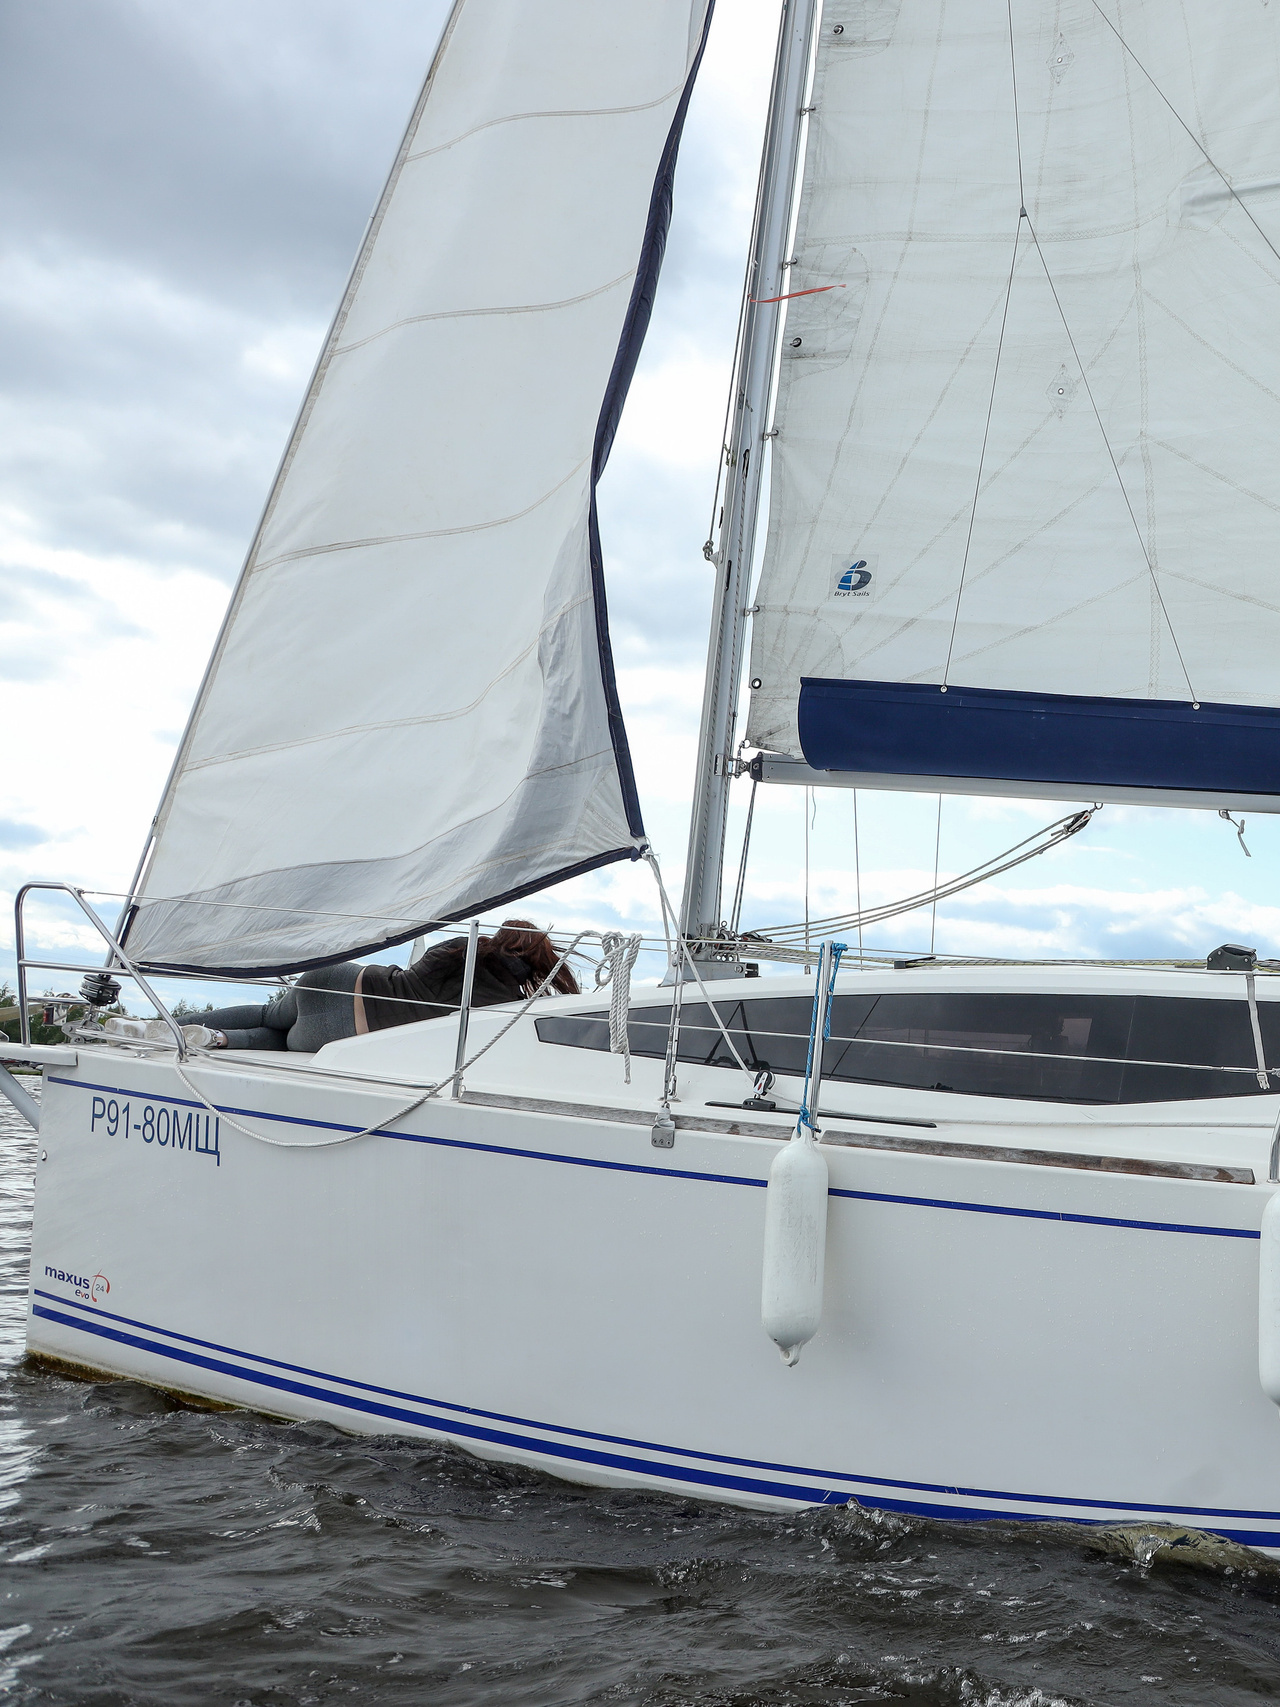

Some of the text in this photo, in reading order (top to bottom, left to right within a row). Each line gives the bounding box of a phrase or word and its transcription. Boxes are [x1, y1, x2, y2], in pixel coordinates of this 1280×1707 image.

[91, 1096, 220, 1167] Р91-80МЩ
[45, 1265, 90, 1289] maxus
[75, 1289, 90, 1299] evo
[95, 1284, 105, 1292] 24
